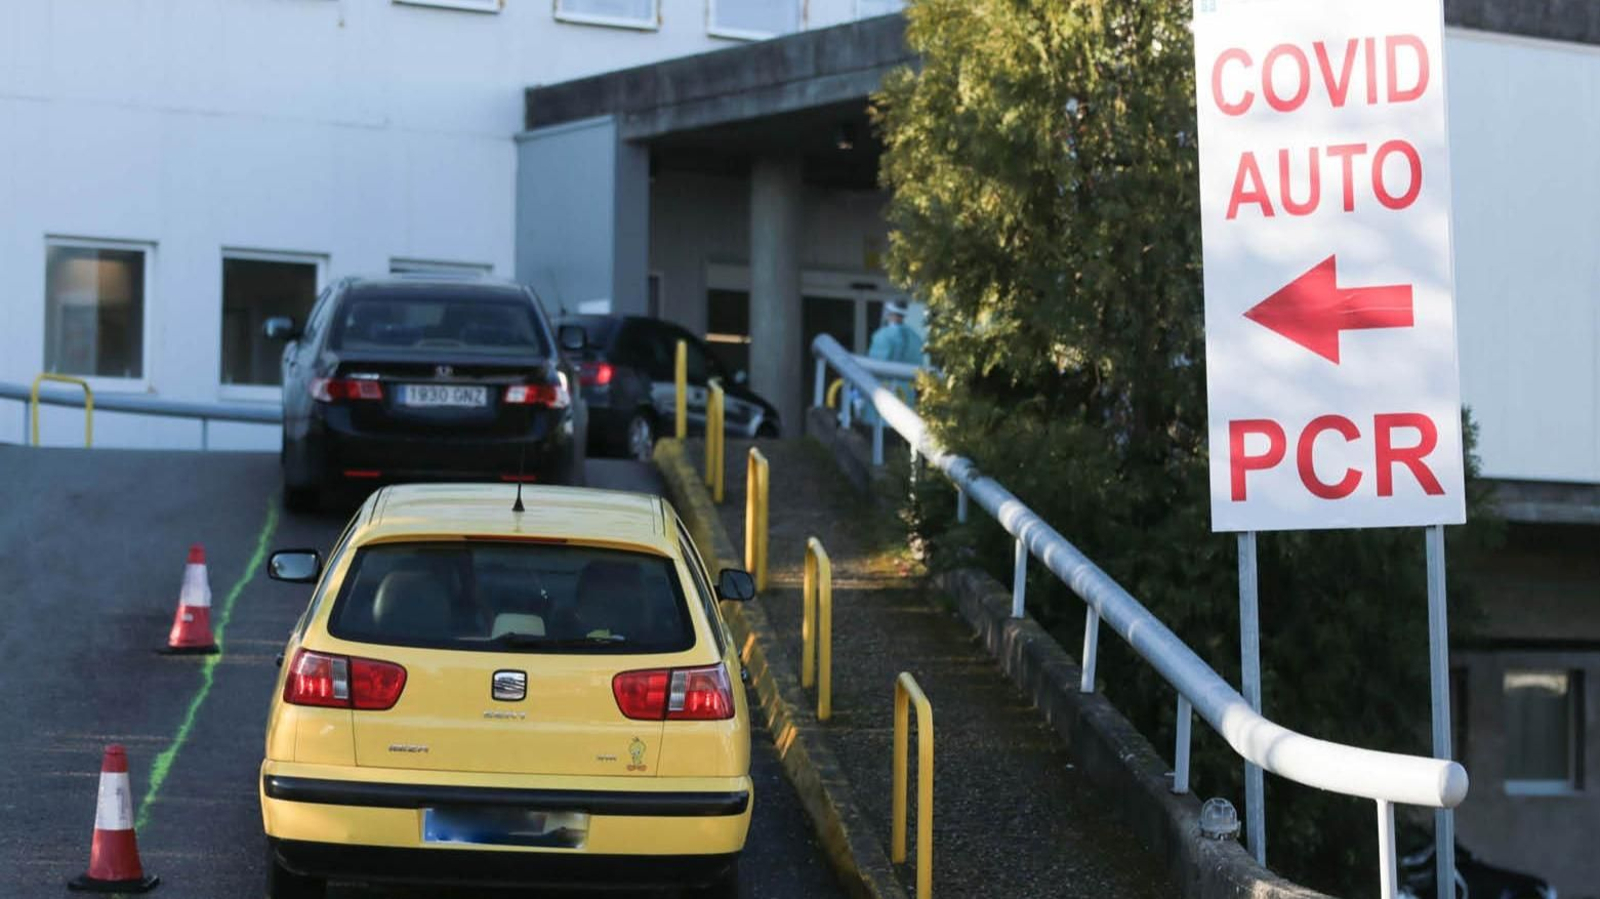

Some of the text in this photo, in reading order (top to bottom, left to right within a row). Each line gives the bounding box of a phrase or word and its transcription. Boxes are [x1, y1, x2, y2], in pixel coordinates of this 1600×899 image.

[1211, 34, 1430, 116] COVID
[1226, 139, 1423, 220] AUTO
[409, 386, 484, 404] 1930 GNZ
[1229, 412, 1447, 502] PCR
